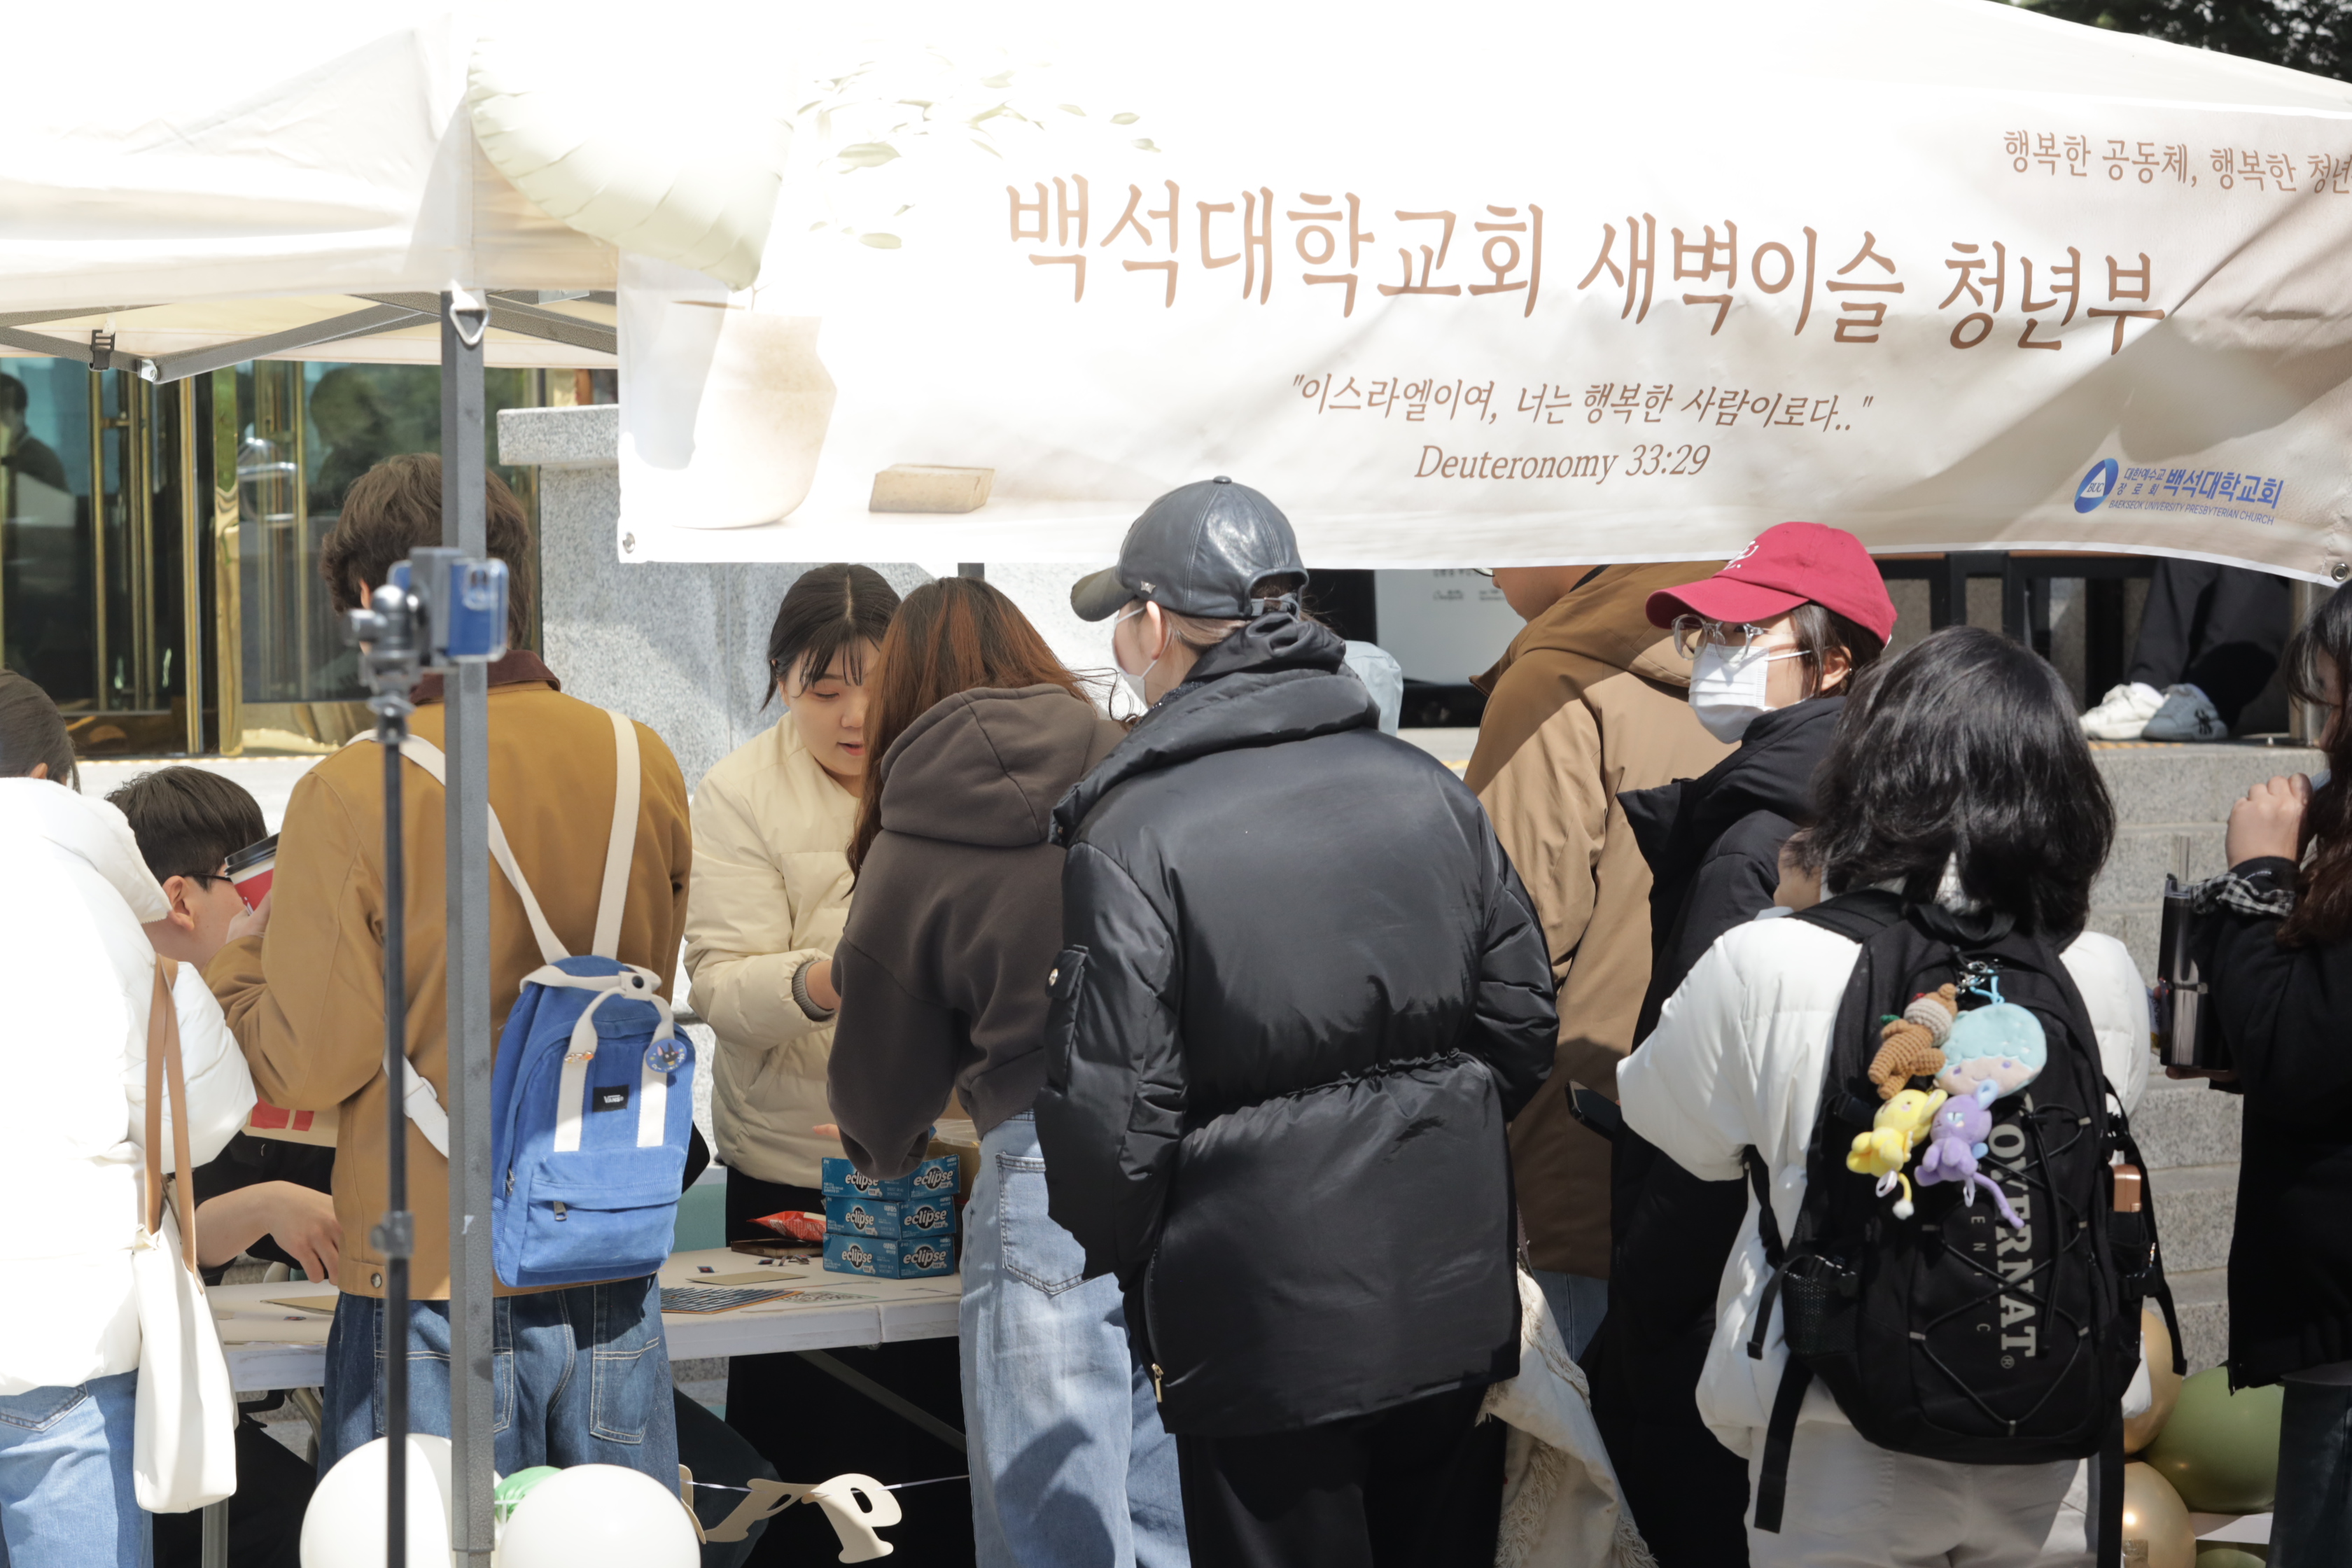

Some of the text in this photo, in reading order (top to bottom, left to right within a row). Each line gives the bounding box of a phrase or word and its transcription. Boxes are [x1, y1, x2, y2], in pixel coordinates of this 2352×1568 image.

[2005, 130, 2092, 177] 행복한
[2104, 140, 2197, 188] 공동체,
[2211, 148, 2297, 192] 행복한
[1006, 173, 2166, 356] 백석대학교회 새벽이슬 청년부
[1294, 372, 1498, 425] "이스라엘이여,
[1518, 383, 1573, 425] 너는
[1585, 382, 1674, 425] 행복한
[1414, 444, 1712, 485] Deuteronomy 33:29
[2124, 468, 2166, 482] 대한예수교
[2087, 482, 2104, 493] BUC
[2163, 468, 2284, 510] 백석대학교회
[2108, 500, 2274, 526] BAEKSEOK UNIVERSITY PRESBYTERIAN CHURCH
[913, 1169, 954, 1189] eclipse
[845, 1210, 874, 1228] eclipse
[904, 1209, 947, 1228] eclipse
[841, 1247, 872, 1266] eclipse
[903, 1248, 946, 1266] eclipse
